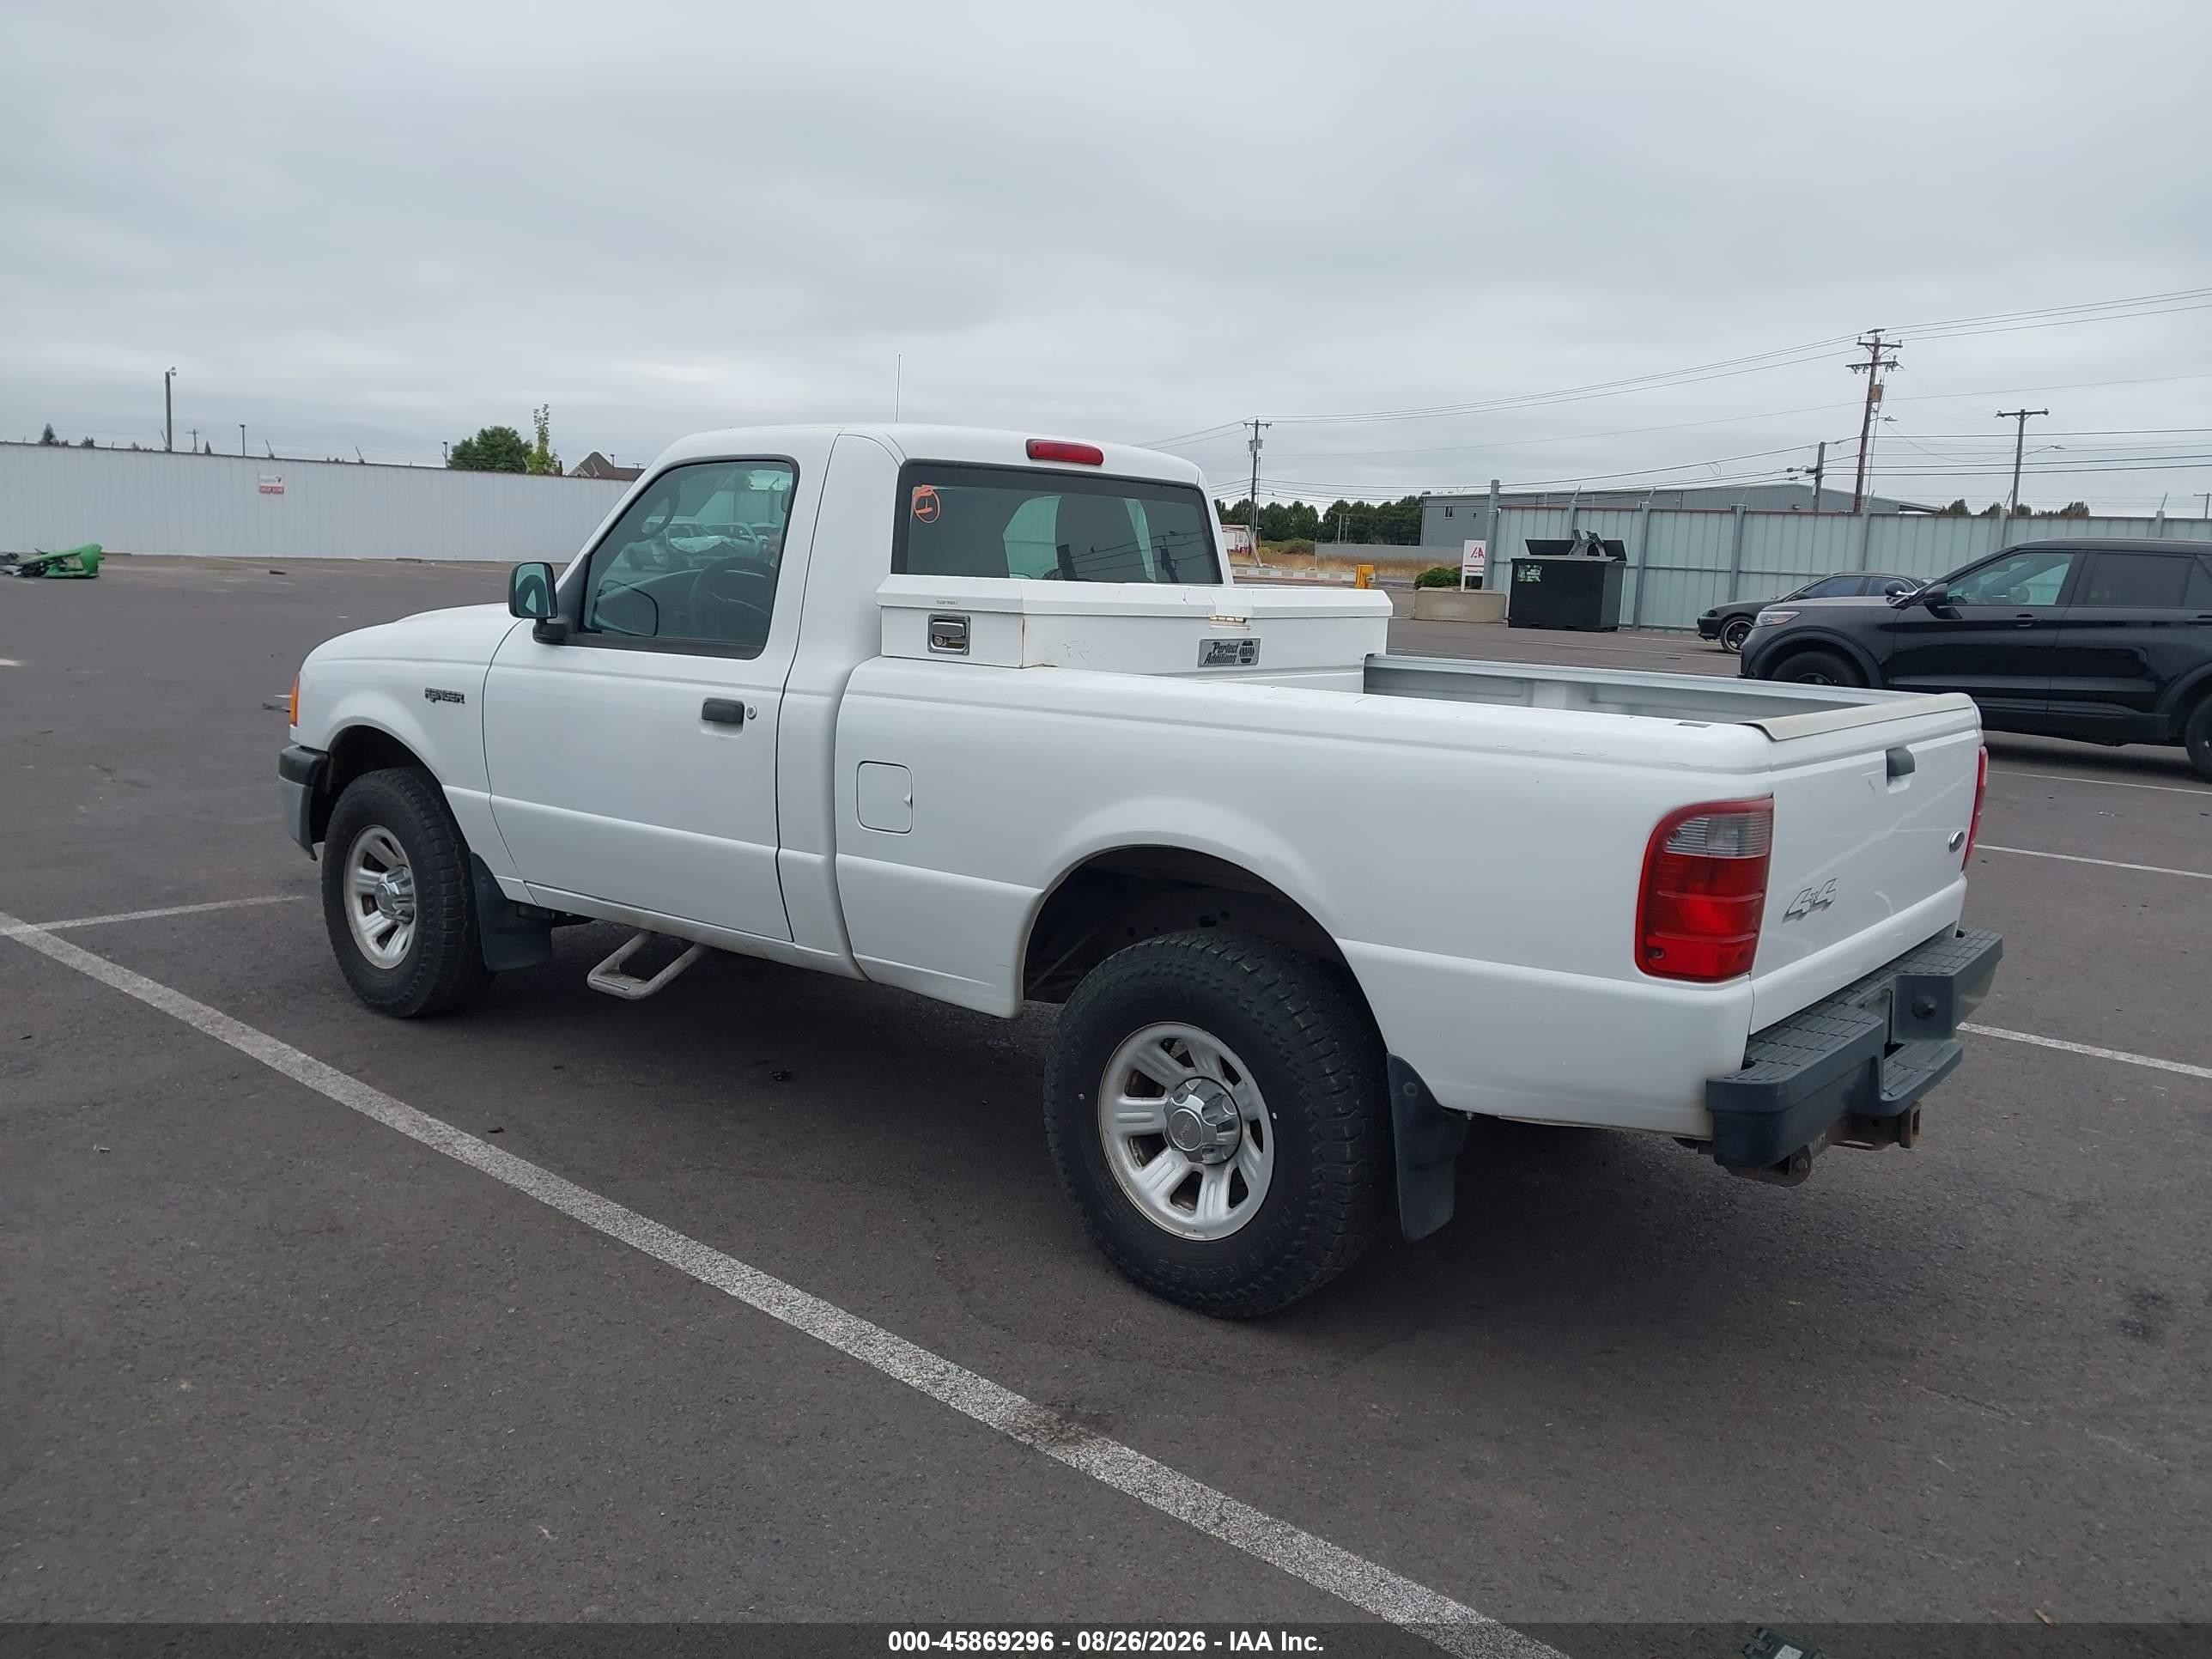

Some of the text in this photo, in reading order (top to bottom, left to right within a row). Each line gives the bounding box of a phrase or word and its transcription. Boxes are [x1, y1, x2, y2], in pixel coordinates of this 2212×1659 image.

[1211, 641, 1239, 654] Perfect
[1241, 646, 1255, 658] NAPA
[1203, 652, 1237, 665] Additions
